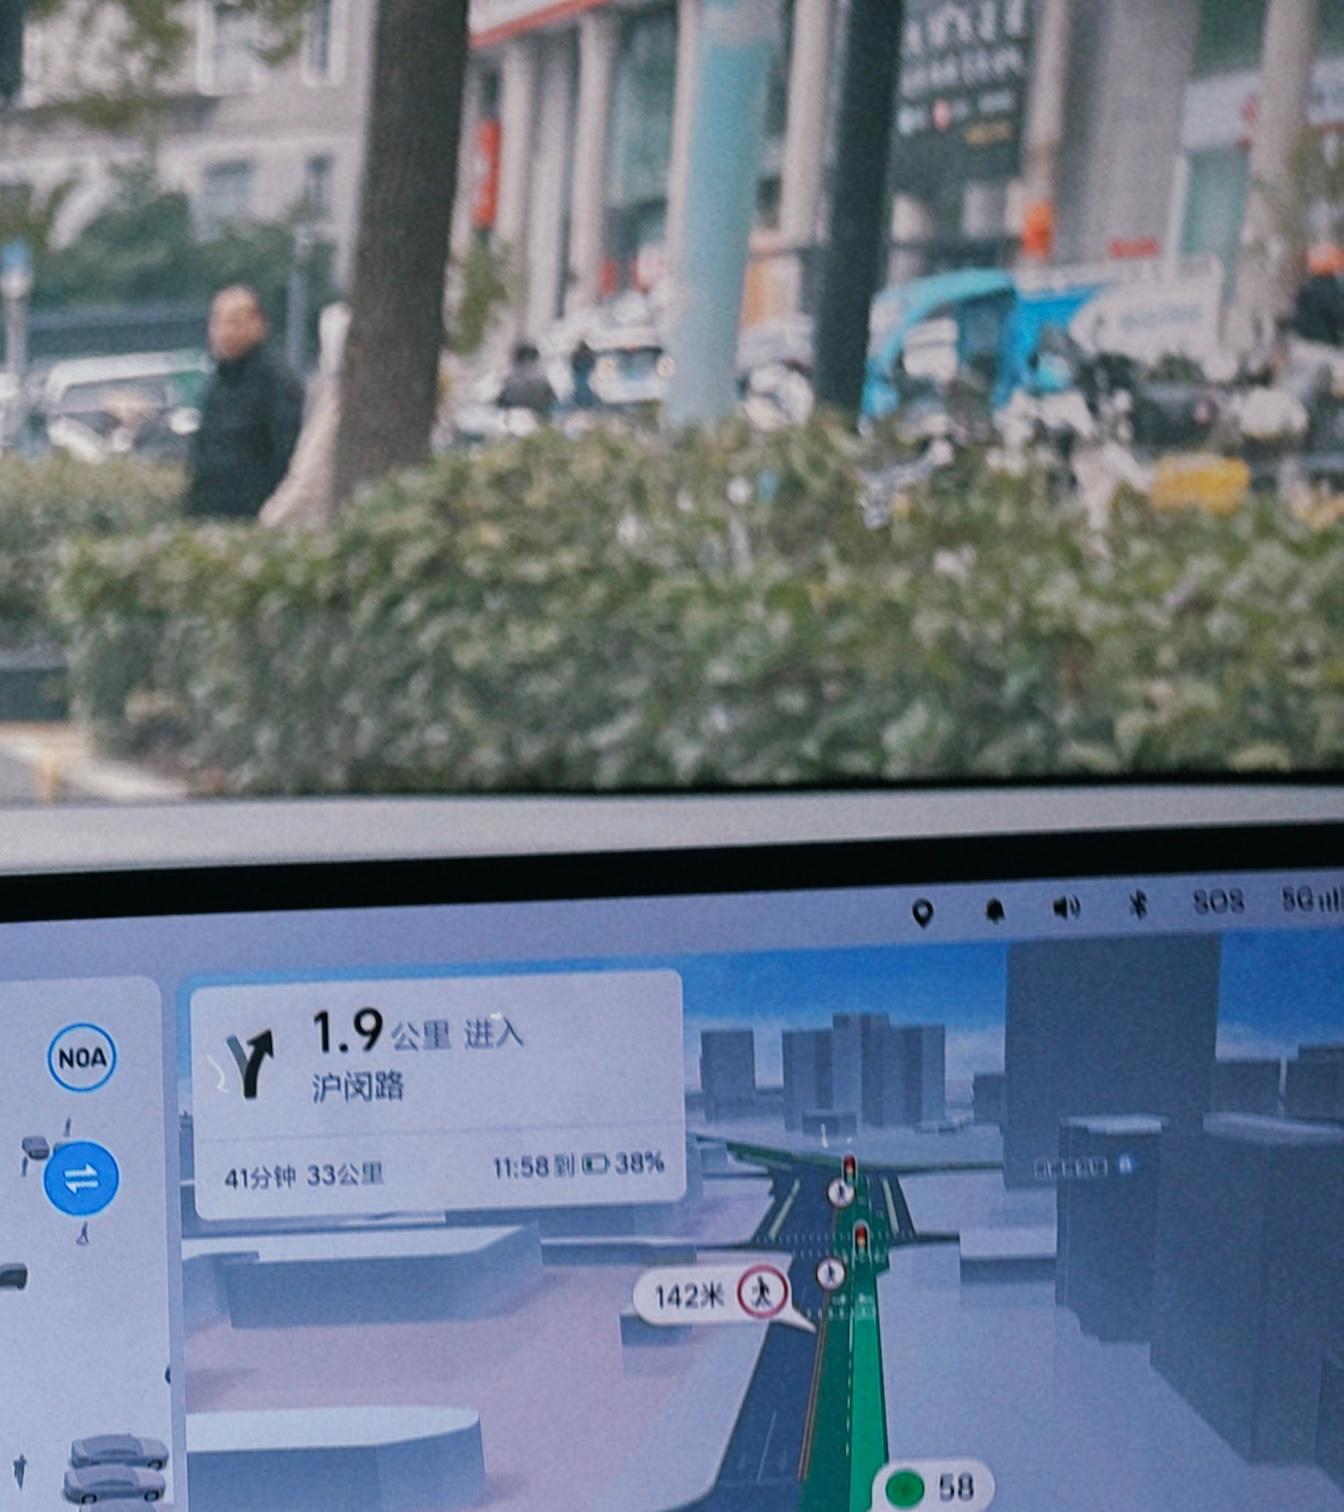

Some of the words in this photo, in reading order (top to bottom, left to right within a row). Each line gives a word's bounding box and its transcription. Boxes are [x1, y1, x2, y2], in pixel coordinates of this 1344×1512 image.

[1193, 888, 1245, 916] SOS
[1282, 885, 1314, 912] 5G
[464, 1016, 525, 1051] 进入
[58, 1046, 108, 1070] NOA
[312, 1070, 405, 1104] 沪闵路
[224, 1165, 297, 1190] 41分钟
[306, 1162, 384, 1187] 33公里
[615, 1151, 665, 1175] 38%
[656, 1283, 725, 1309] 142米
[939, 1472, 975, 1502] 58
